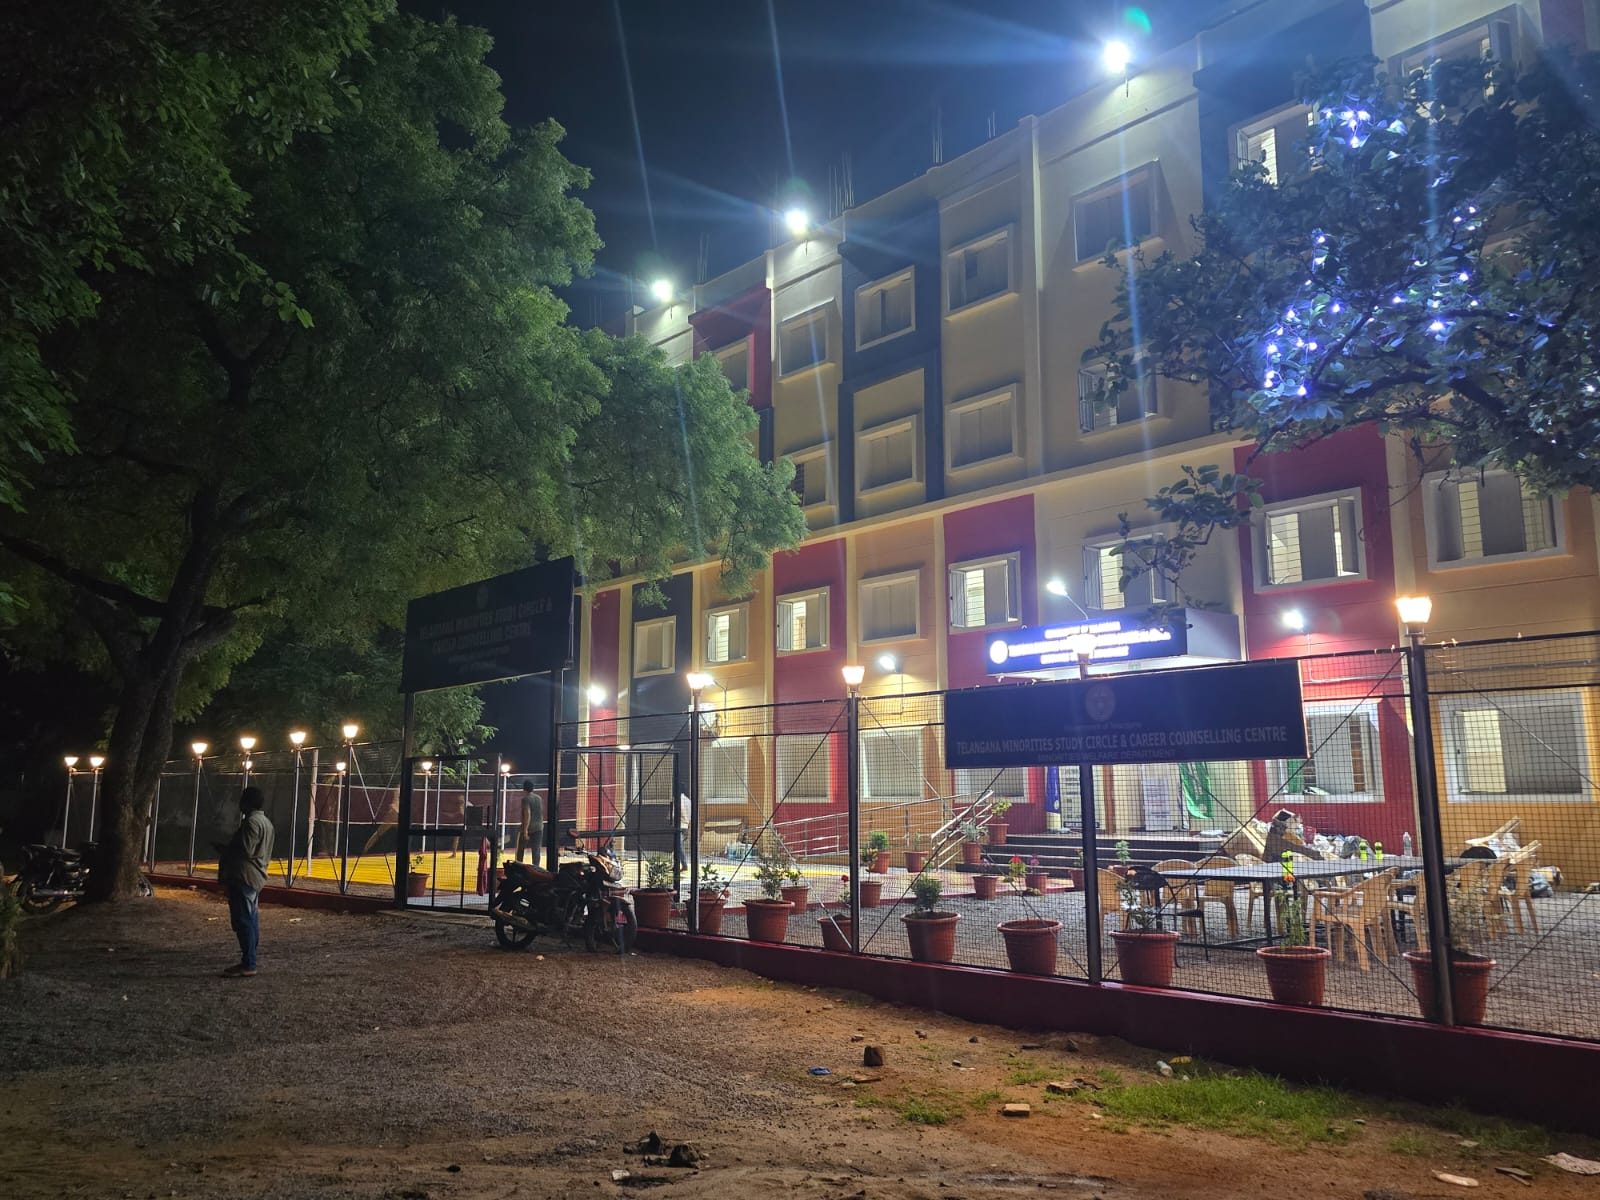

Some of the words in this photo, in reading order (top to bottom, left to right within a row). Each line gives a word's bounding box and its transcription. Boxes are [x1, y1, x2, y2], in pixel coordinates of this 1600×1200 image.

[957, 740, 1001, 755] TELANGANA
[1002, 737, 1053, 752] MINORITIES
[1055, 735, 1083, 751] STUDY
[1085, 733, 1117, 750] CIRCLE
[1120, 734, 1128, 748] &
[1129, 731, 1167, 747] CAREER
[1169, 727, 1242, 747] COUNSELLING
[1244, 725, 1288, 742] CENTRE
